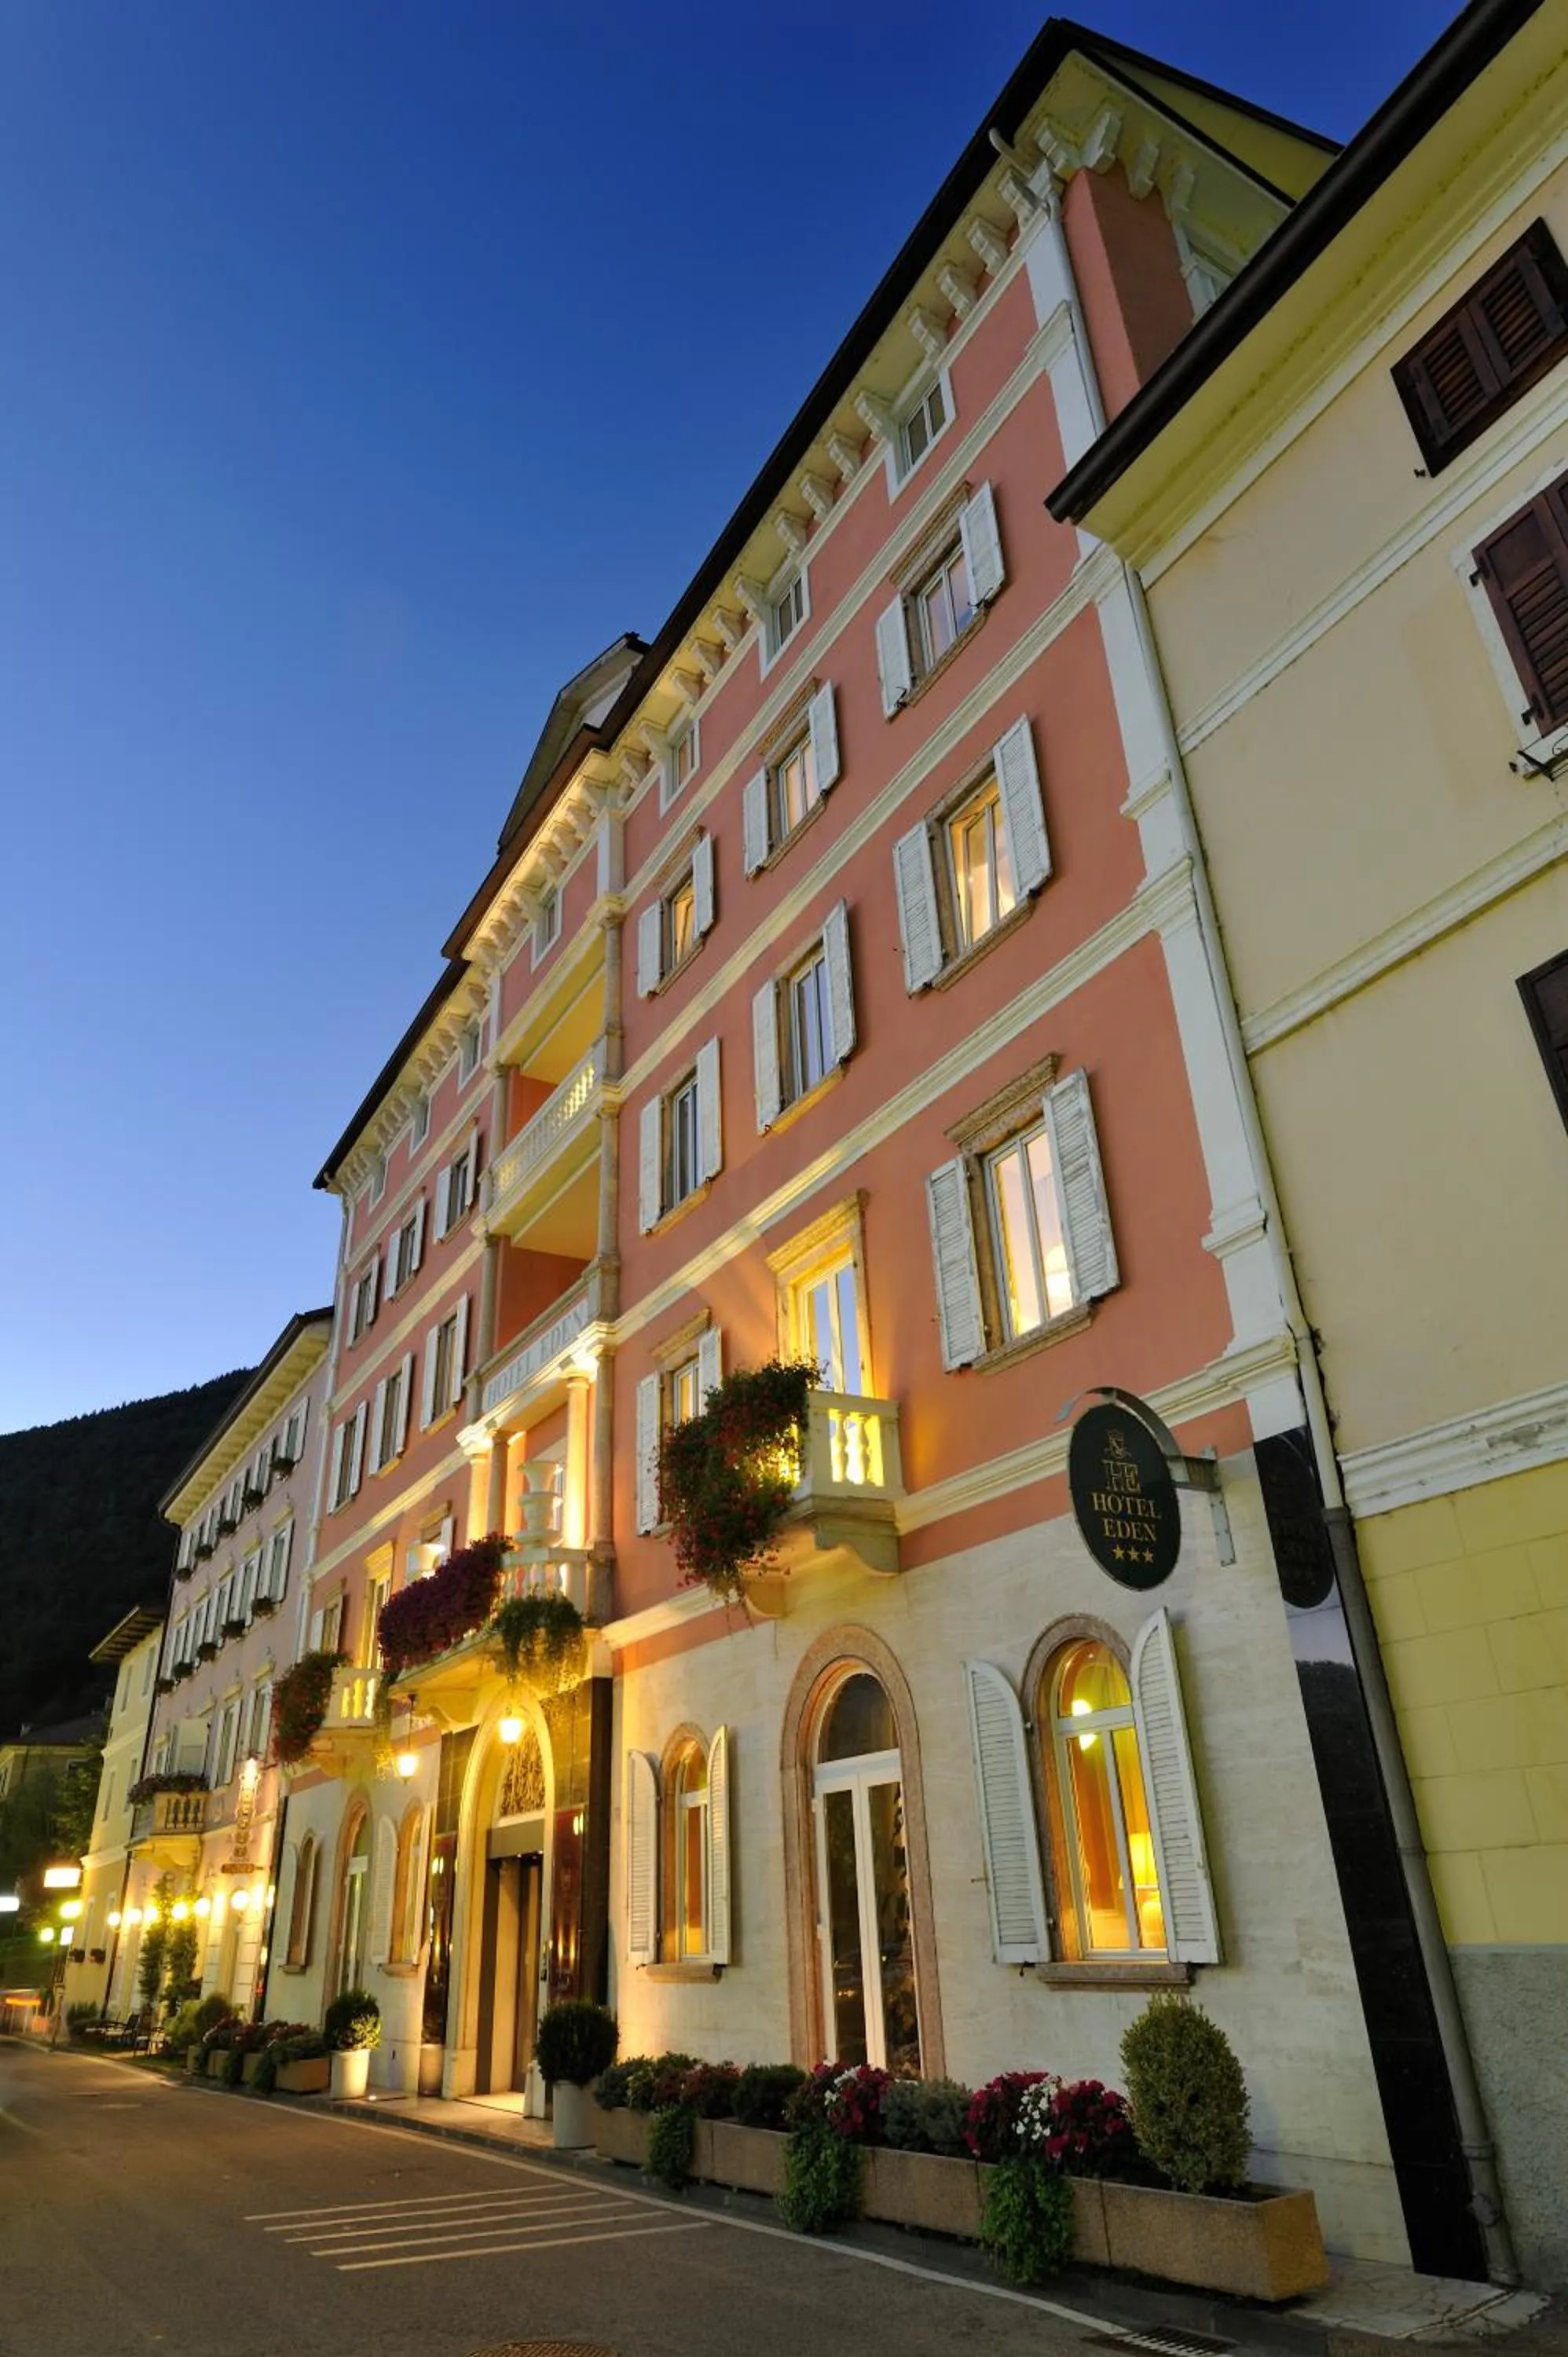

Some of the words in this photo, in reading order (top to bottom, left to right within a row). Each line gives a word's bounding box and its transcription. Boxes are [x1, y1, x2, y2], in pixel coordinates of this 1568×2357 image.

[488, 1349, 535, 1409] HOTEL
[539, 1300, 588, 1365] EDEN
[1091, 1492, 1161, 1519] HOTEL
[1102, 1518, 1156, 1541] EDEN
